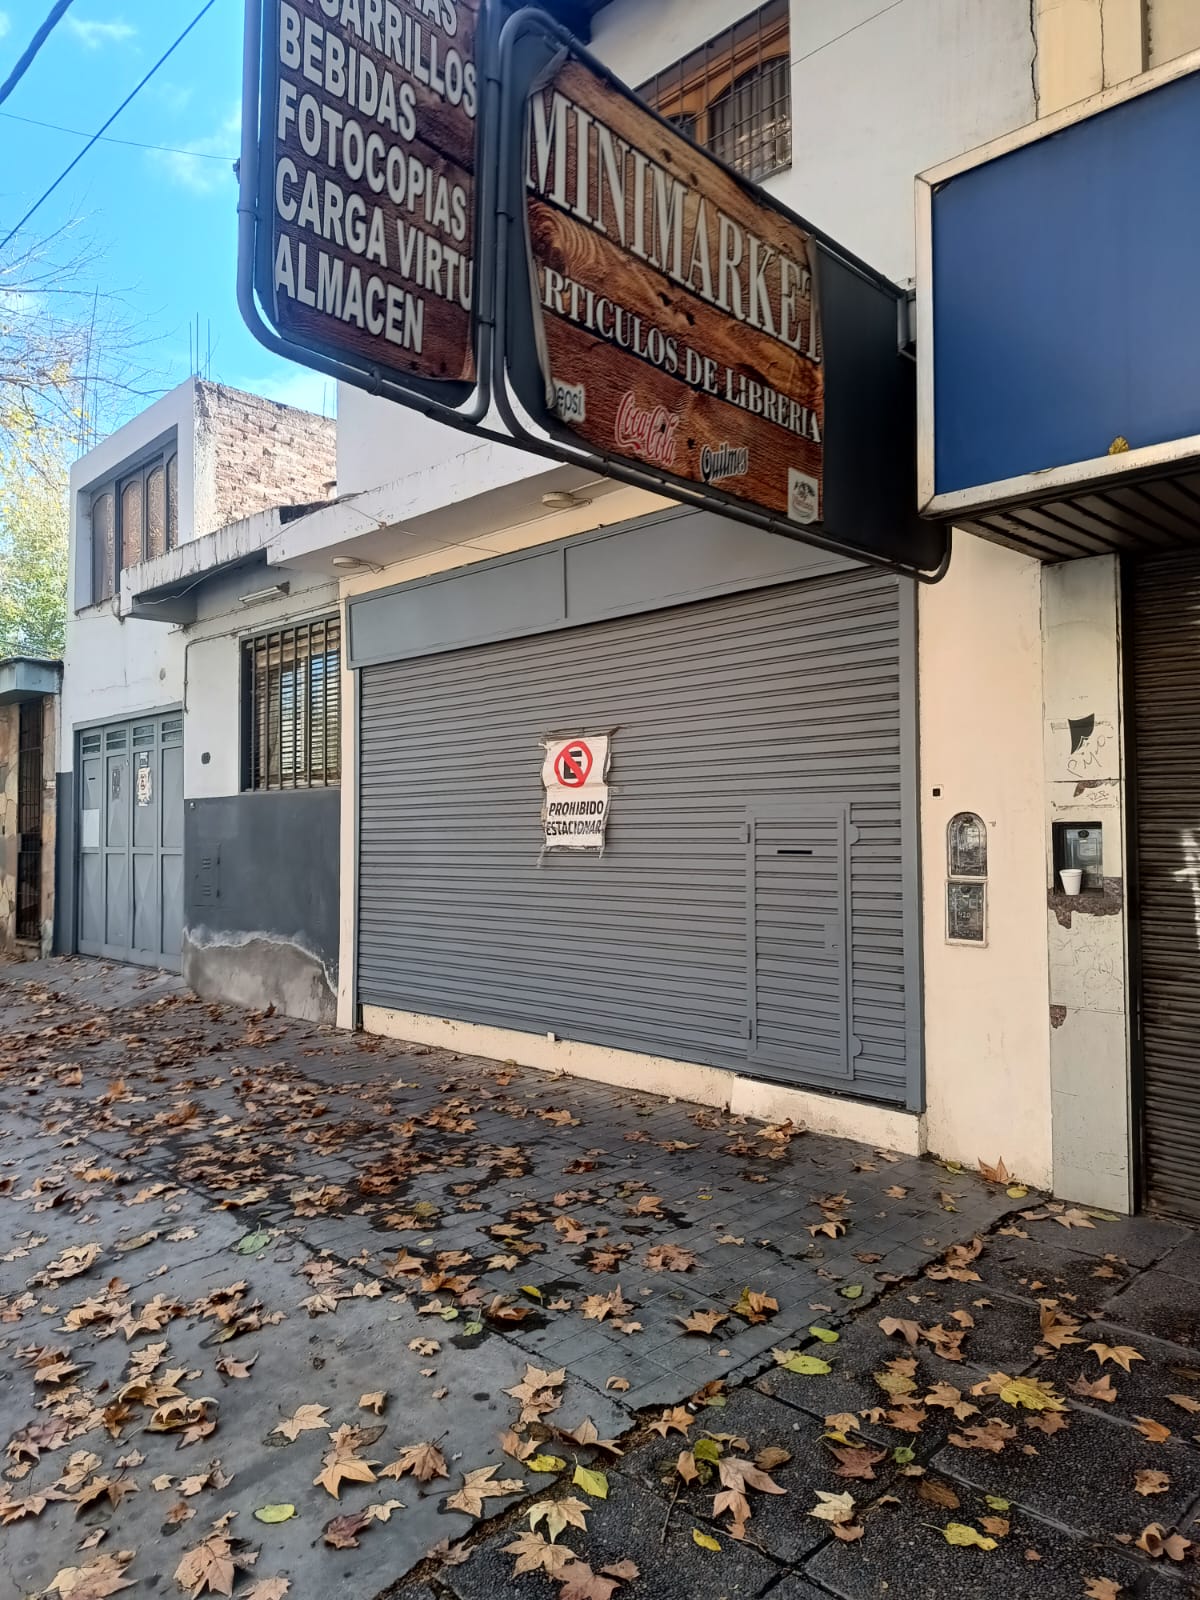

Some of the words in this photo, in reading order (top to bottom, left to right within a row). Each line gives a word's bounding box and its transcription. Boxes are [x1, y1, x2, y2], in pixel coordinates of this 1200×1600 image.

[279, 1, 417, 142] BEBIDAS
[305, 0, 477, 118] ARRILLOS
[275, 157, 388, 267] CARGA
[277, 78, 466, 241] FOTOCOPIAS
[275, 233, 424, 354] ALMACEN
[540, 266, 678, 374] RTICULOS
[685, 349, 718, 395] DE
[725, 367, 821, 443] LIBRERIA
[555, 386, 583, 417] epsi
[546, 820, 604, 836] ESTACIONAR
[549, 800, 604, 816] PROHIBIDO
